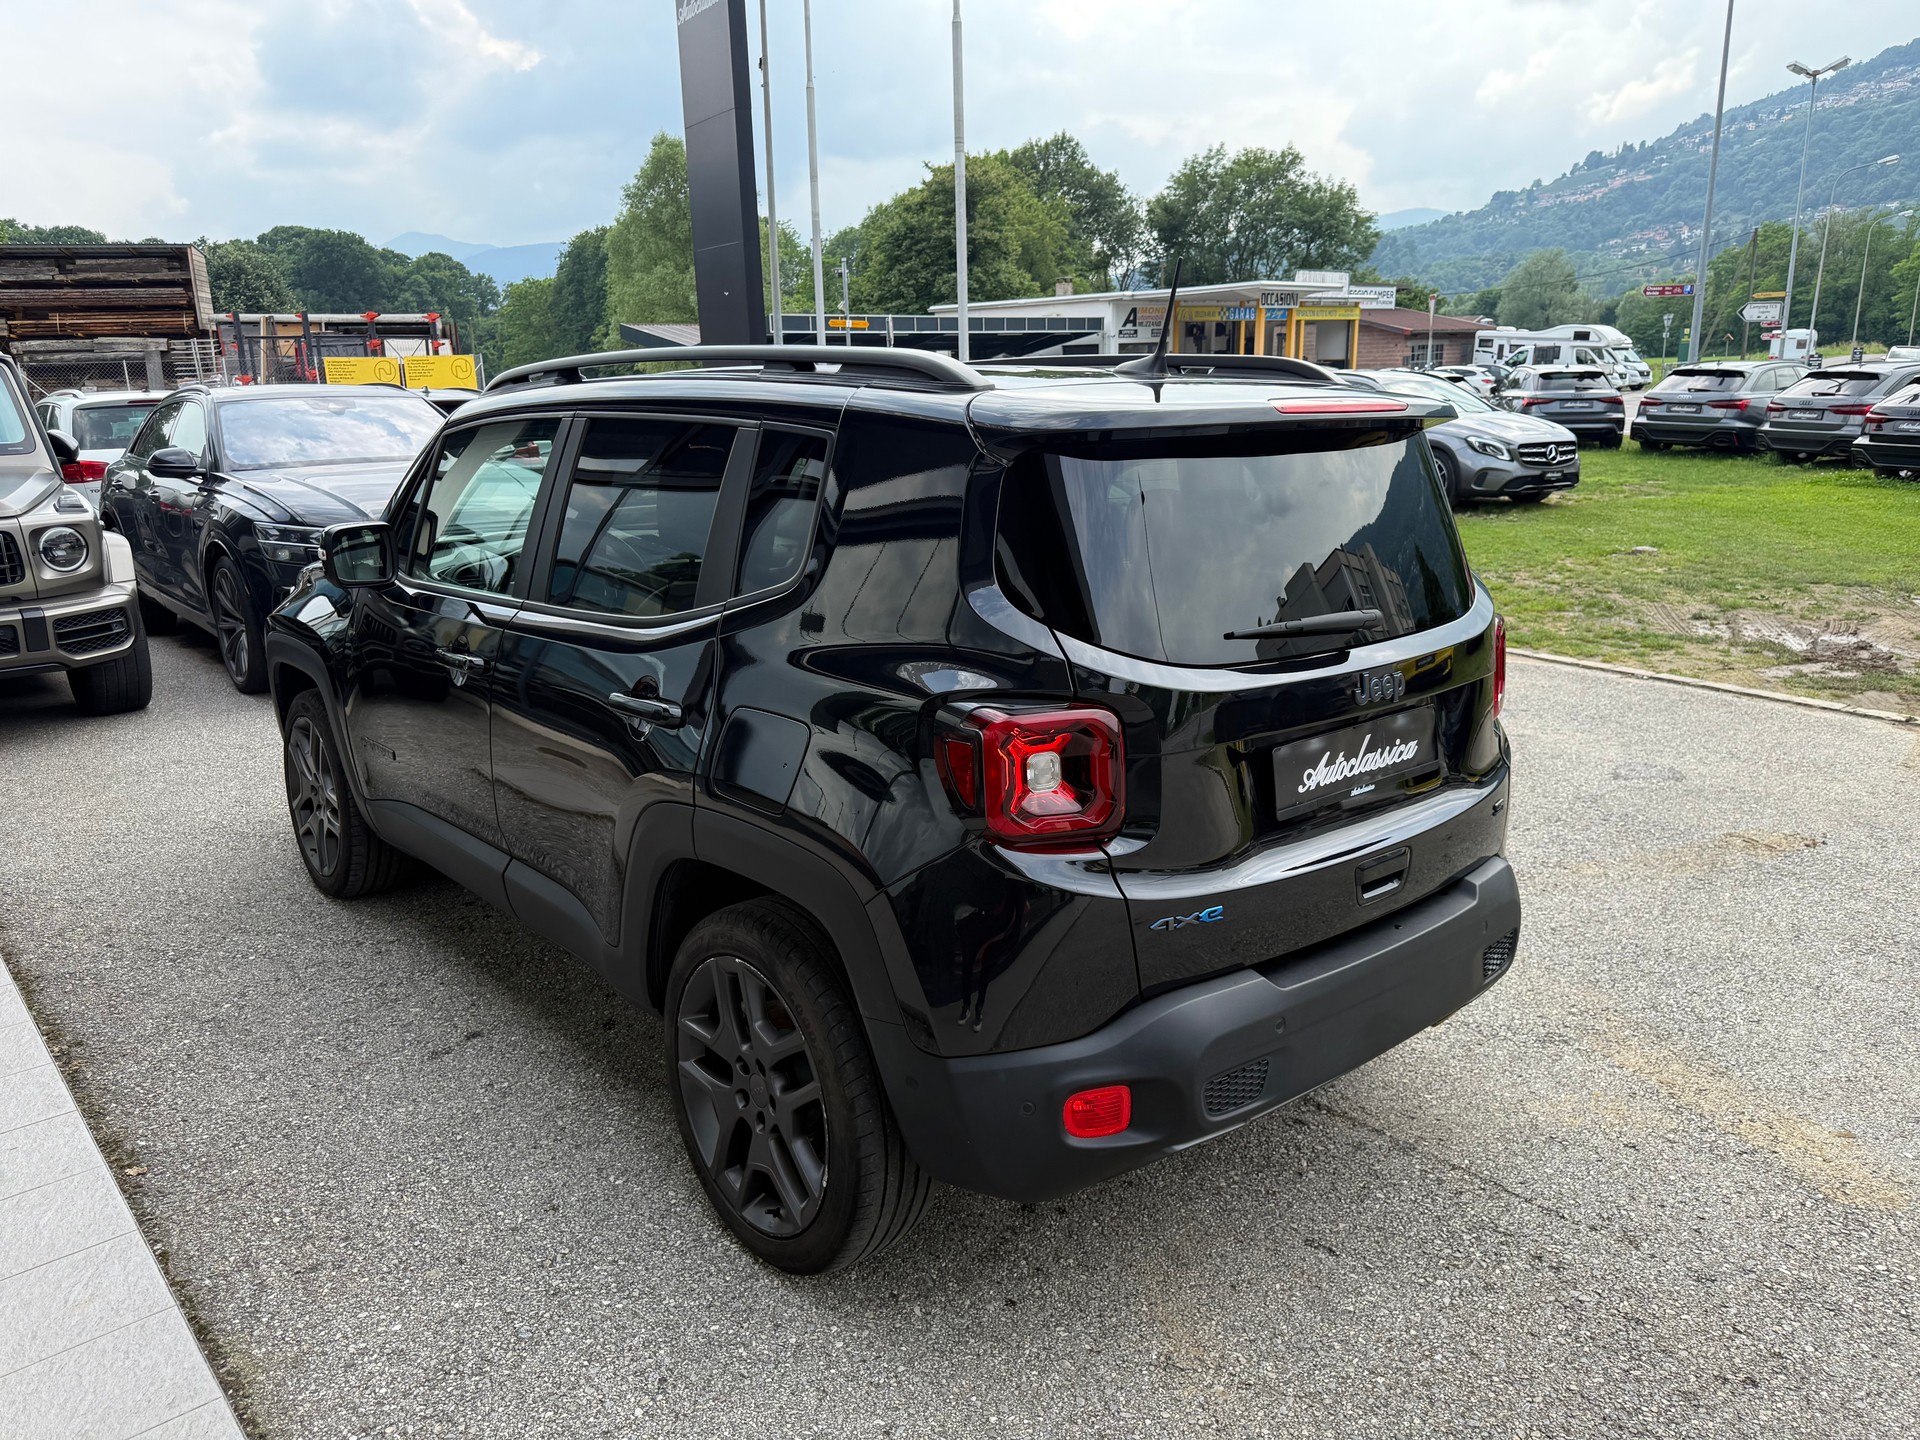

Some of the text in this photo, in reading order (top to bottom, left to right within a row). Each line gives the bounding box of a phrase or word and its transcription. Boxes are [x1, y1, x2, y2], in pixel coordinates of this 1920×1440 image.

[1260, 292, 1299, 306] OCCASIONI
[1229, 307, 1256, 320] GARAG
[1354, 671, 1405, 706] Jeep
[1297, 733, 1419, 794] Autoclassica
